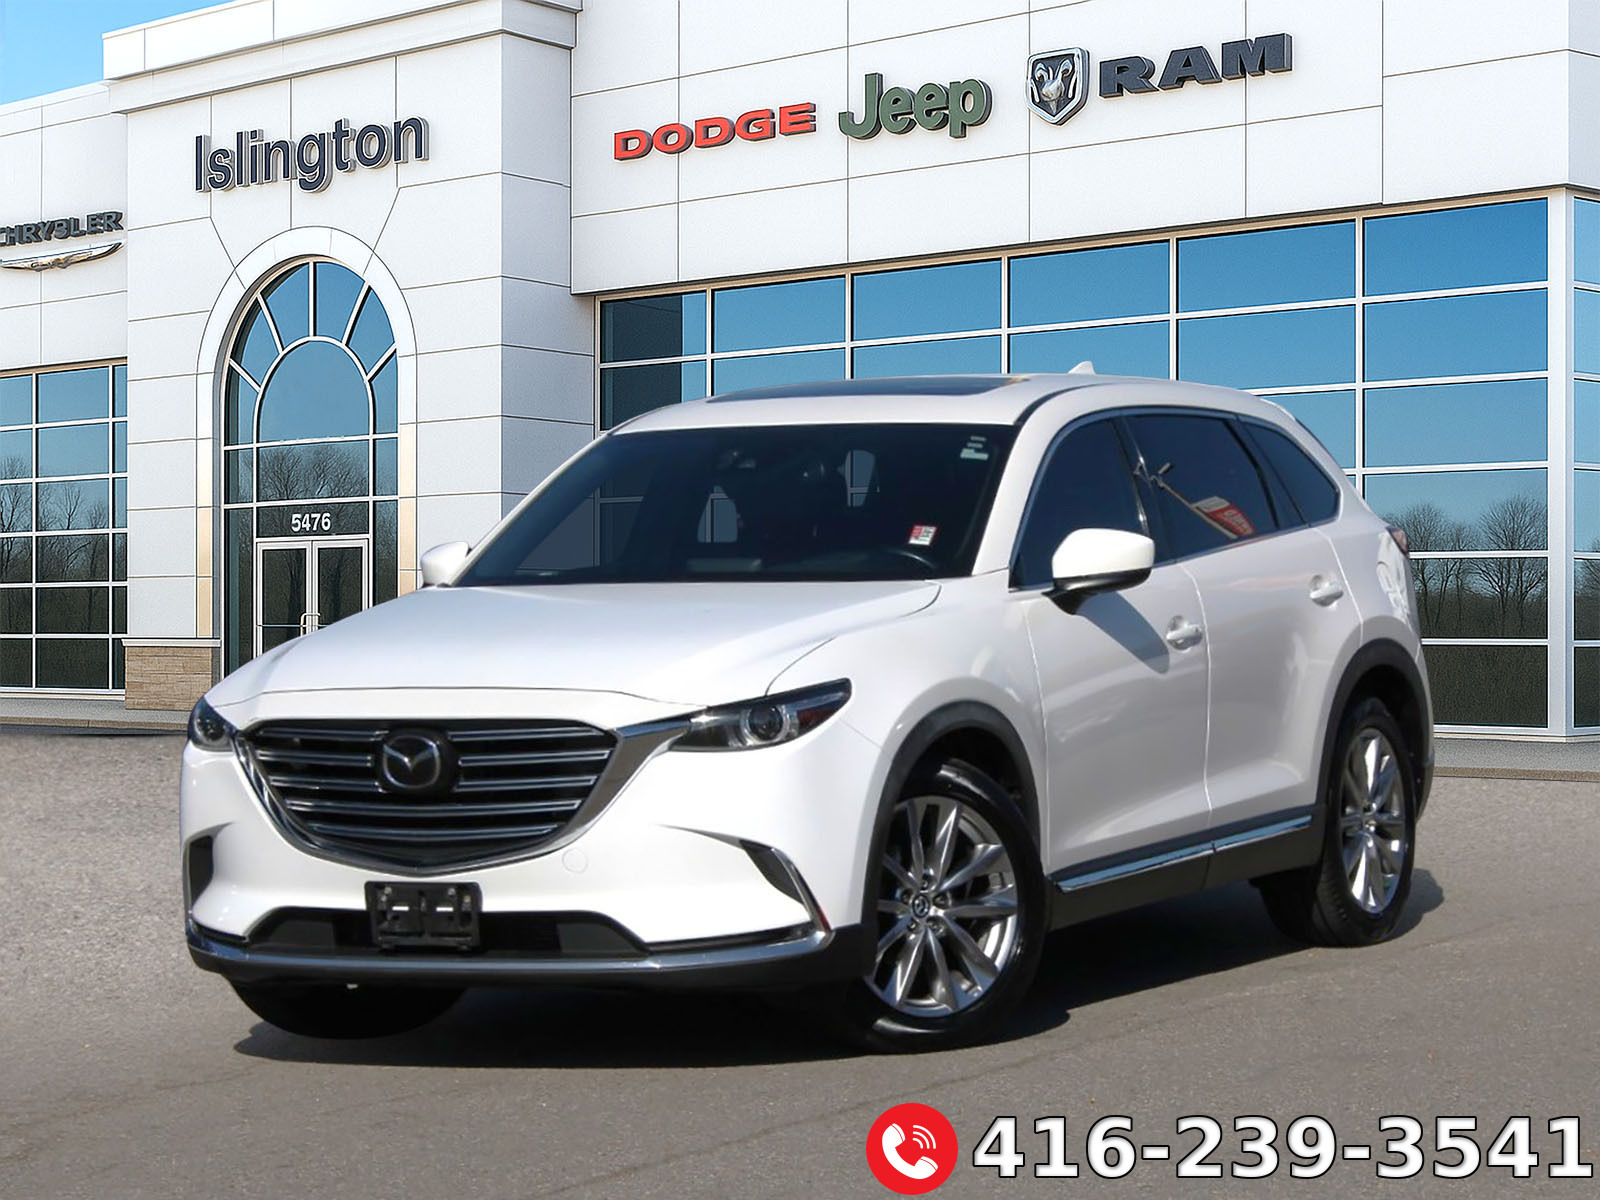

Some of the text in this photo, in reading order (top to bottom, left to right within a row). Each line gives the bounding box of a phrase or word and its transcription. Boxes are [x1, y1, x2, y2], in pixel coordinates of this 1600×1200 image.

[614, 33, 1293, 161] DODGE Jeep RAM
[195, 116, 430, 192] Islington
[291, 512, 331, 532] 5476
